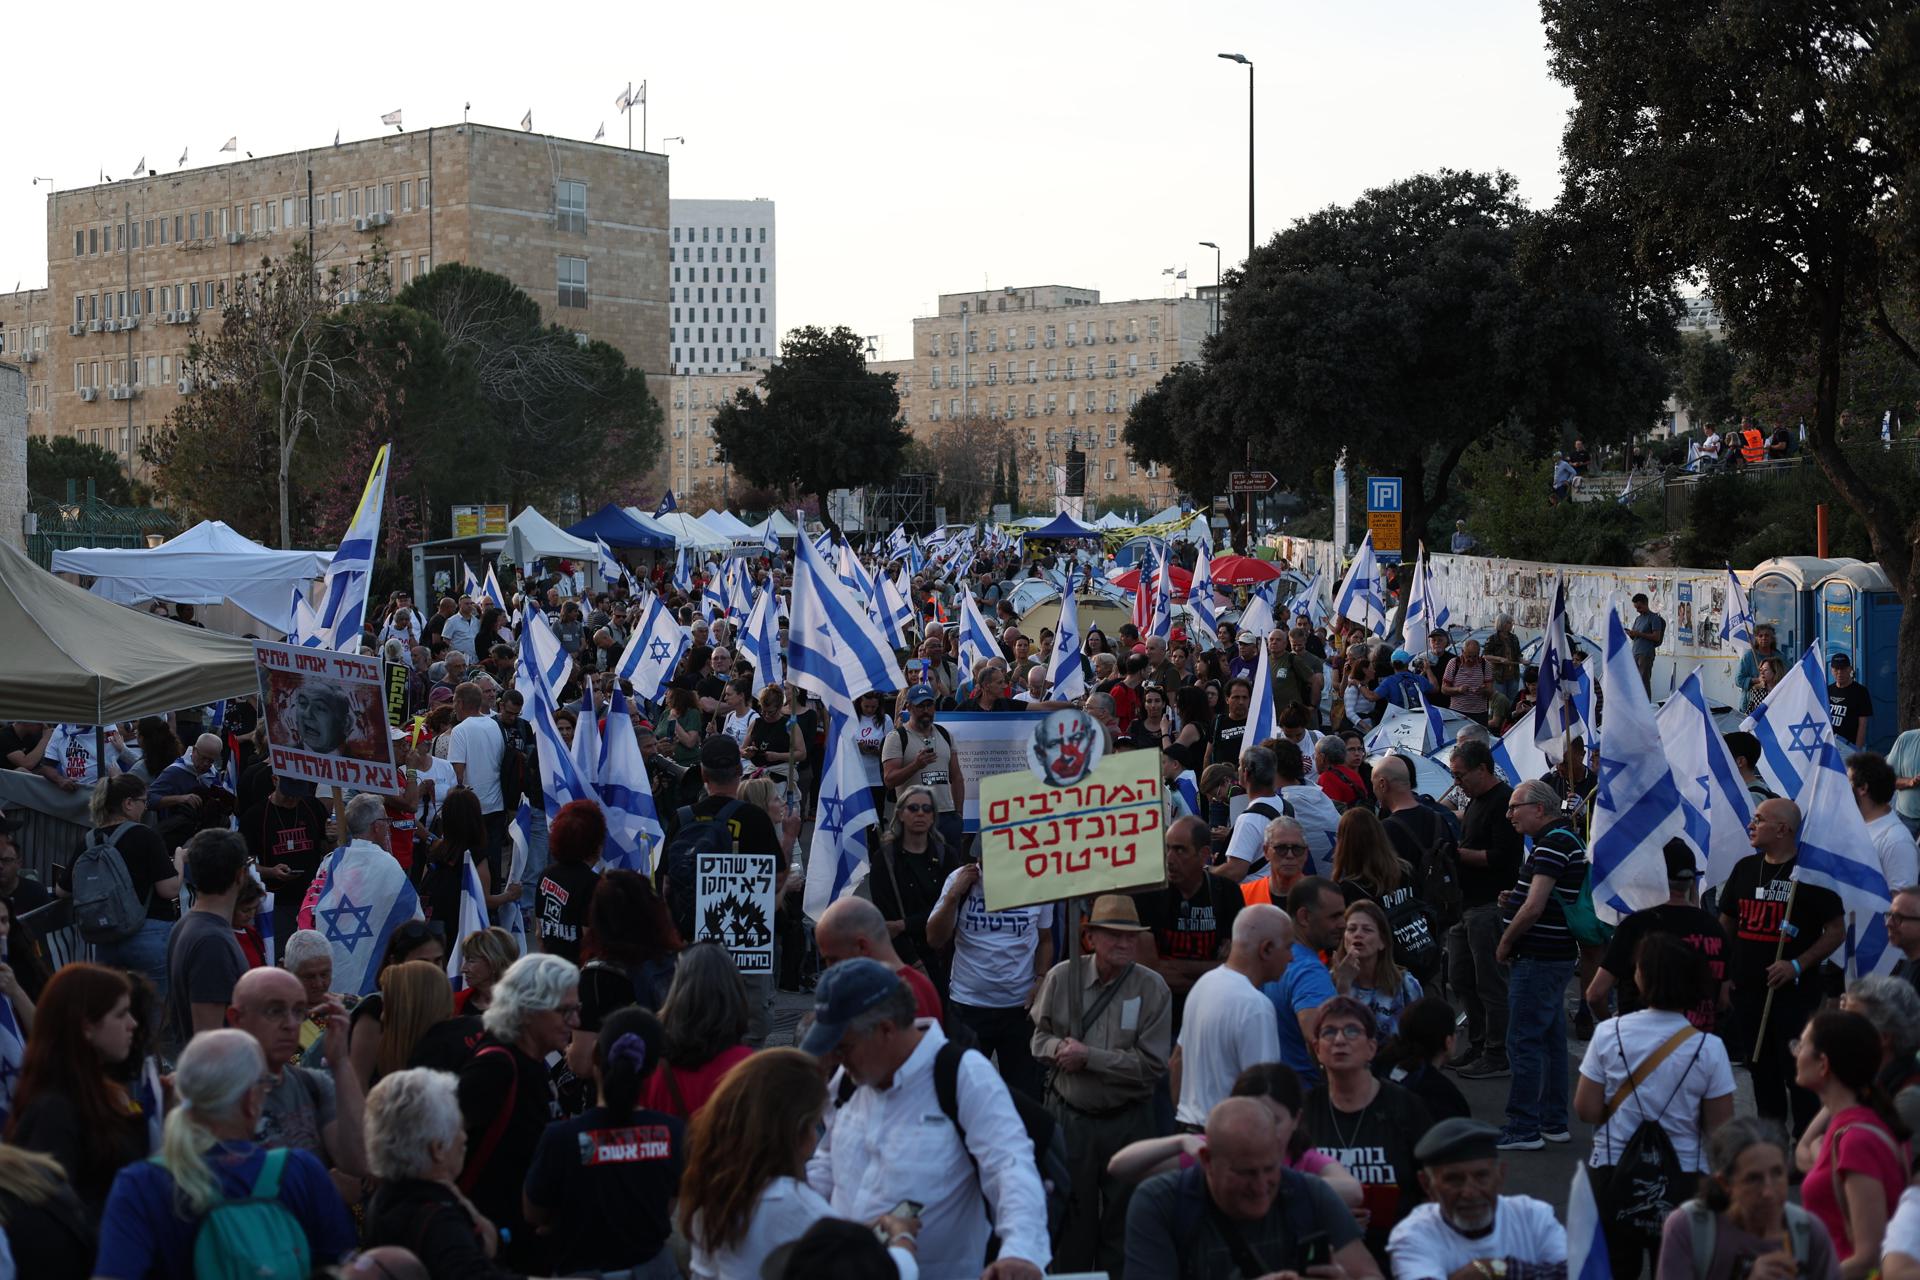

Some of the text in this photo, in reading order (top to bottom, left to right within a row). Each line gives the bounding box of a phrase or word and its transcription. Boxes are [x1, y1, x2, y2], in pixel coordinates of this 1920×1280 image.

[257, 648, 379, 681] בגללך אנחנו מתים
[273, 749, 393, 789] צא לנו מהחיים
[988, 779, 1156, 824] המחריבים
[992, 809, 1160, 851] נבוכדנצר
[700, 857, 773, 875] מי שהרס
[1025, 843, 1137, 879] טיטוס
[702, 876, 772, 896] לא יתקן
[966, 915, 1029, 937] קרטיה
[1393, 917, 1428, 943] שבעה
[736, 953, 769, 967] בחירות
[599, 1141, 668, 1162] אתה אשם
